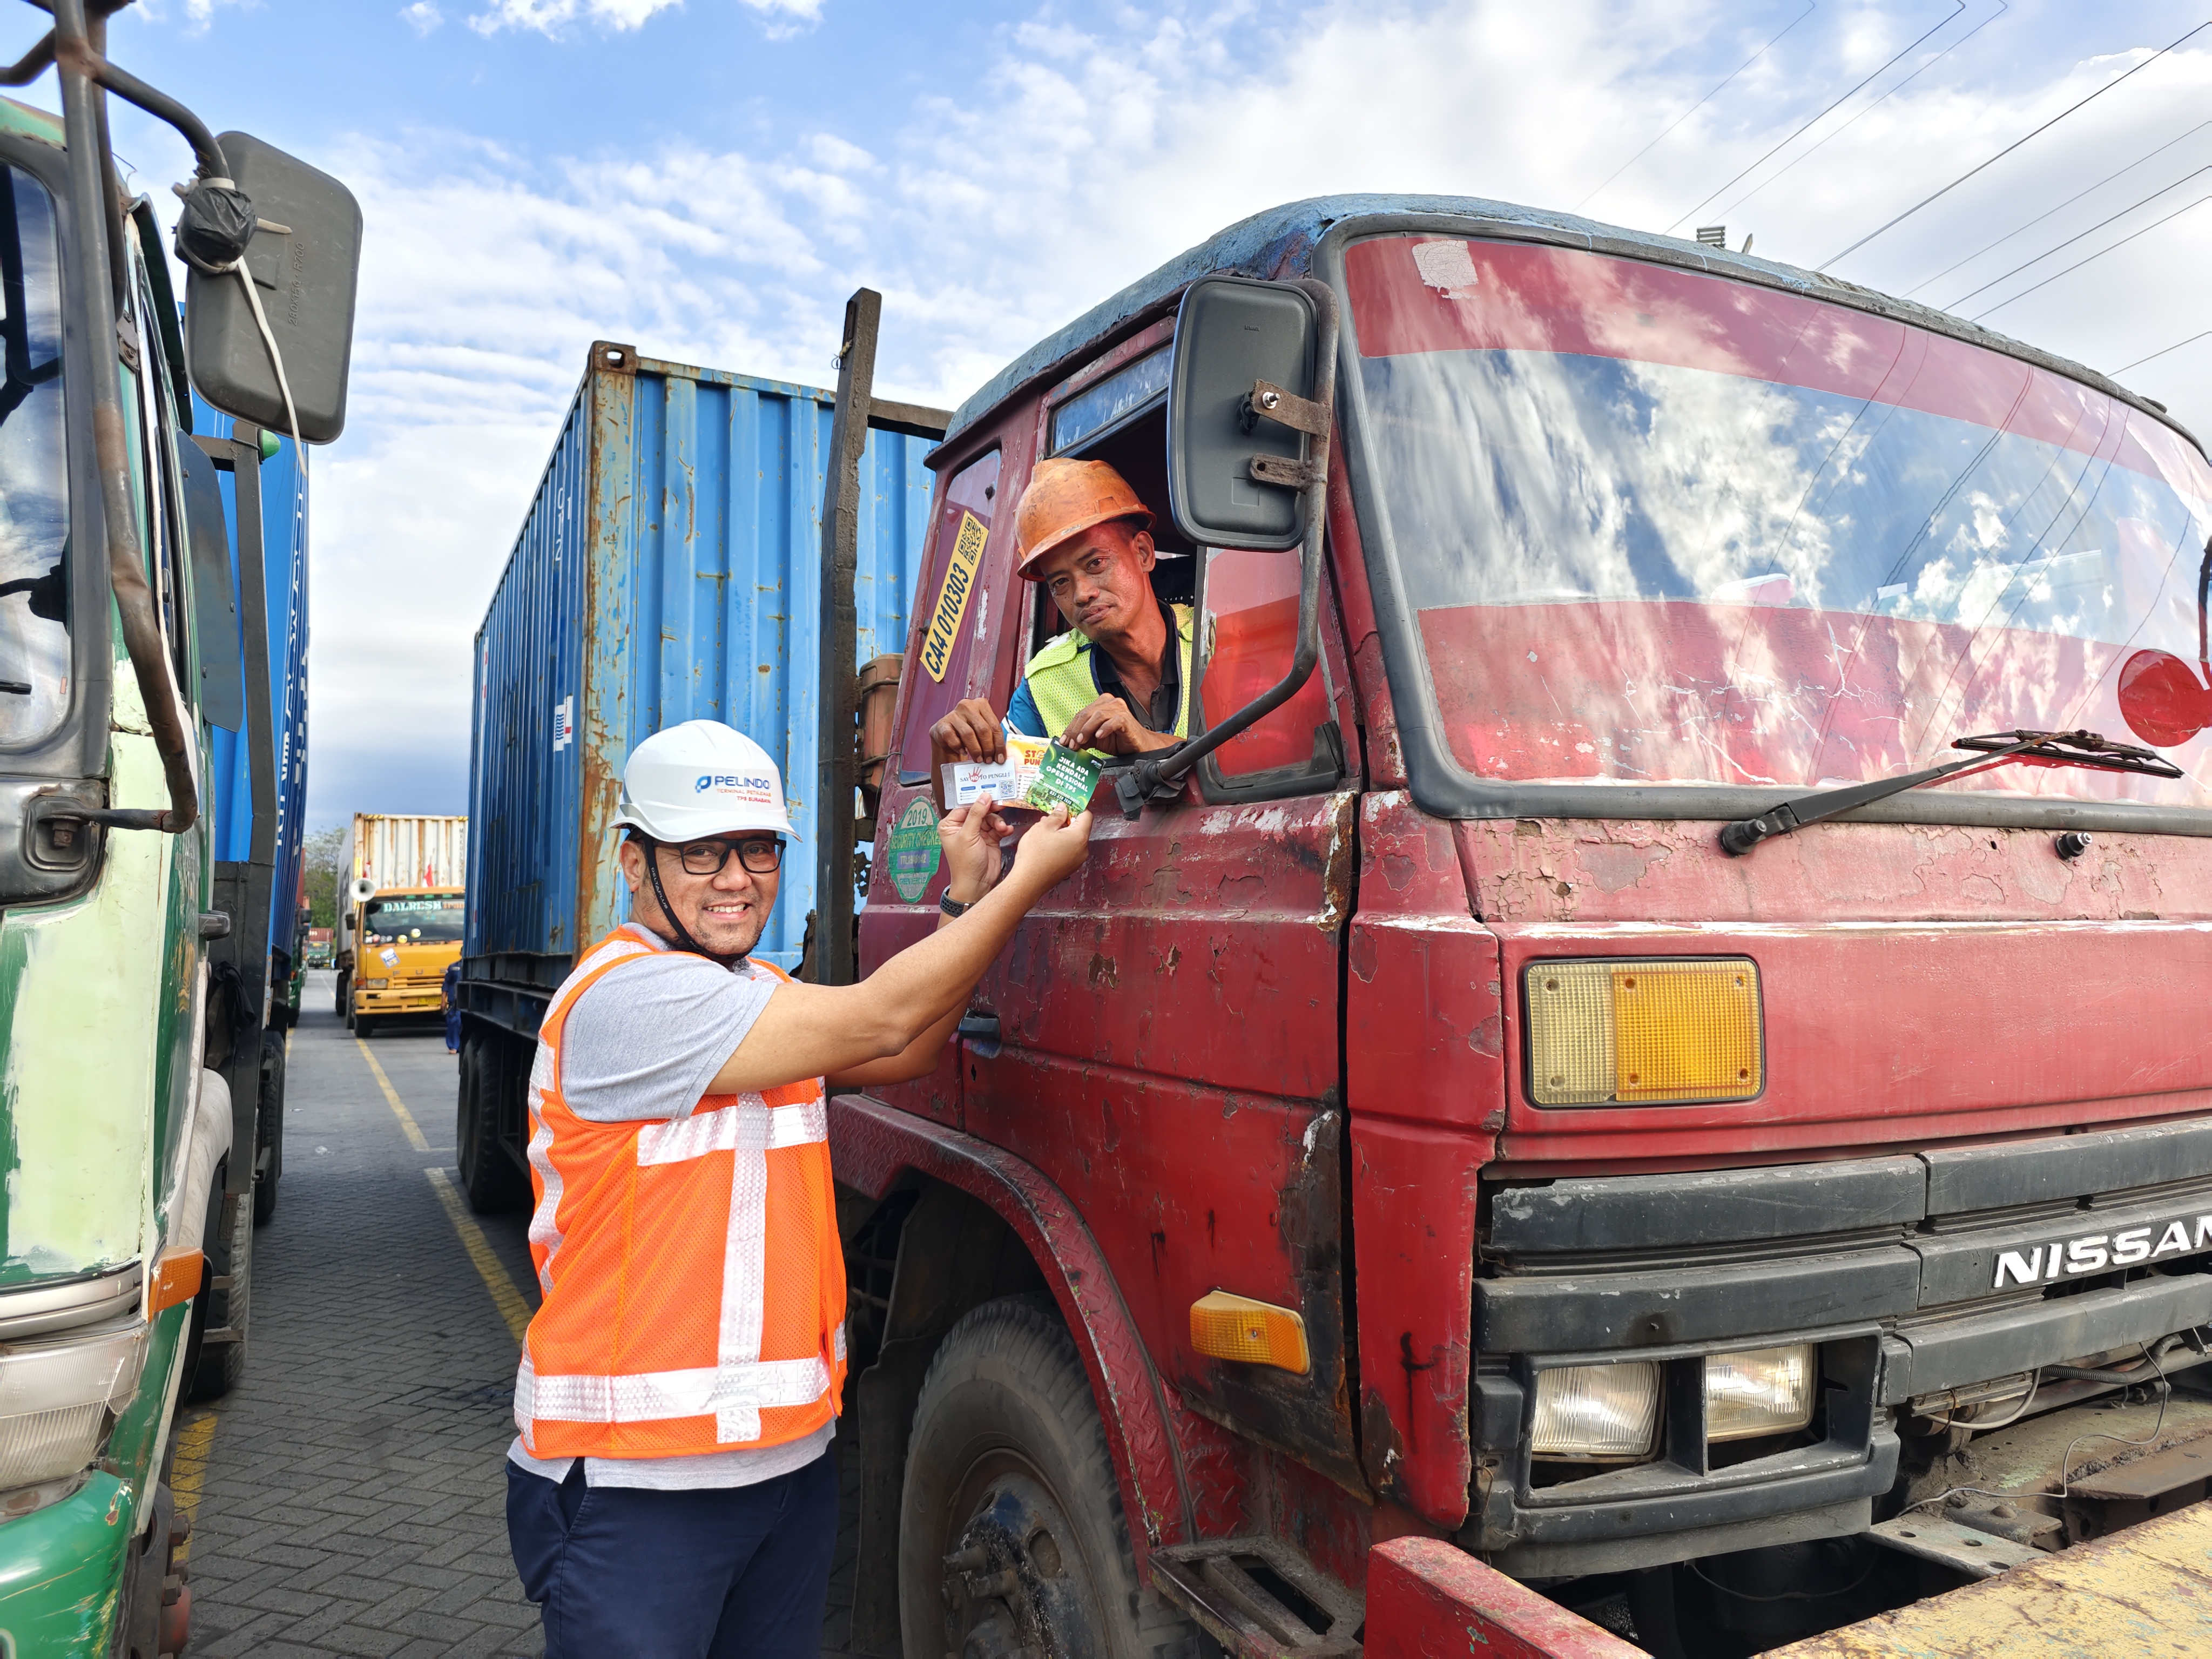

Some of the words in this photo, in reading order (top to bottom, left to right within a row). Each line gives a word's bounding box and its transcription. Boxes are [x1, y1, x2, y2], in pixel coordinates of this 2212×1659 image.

[926, 629, 948, 675] CA4
[937, 563, 969, 636] 010303
[1056, 763, 1085, 782] KENDALA
[1058, 757, 1075, 768] JIKA
[1076, 766, 1089, 776] ADA
[715, 776, 770, 790] PELINDO
[1046, 766, 1088, 792] OPERASIONAL
[1055, 778, 1064, 786] DI
[1065, 783, 1076, 793] TPS
[907, 808, 927, 827] 2019
[891, 833, 916, 849] SECURITY
